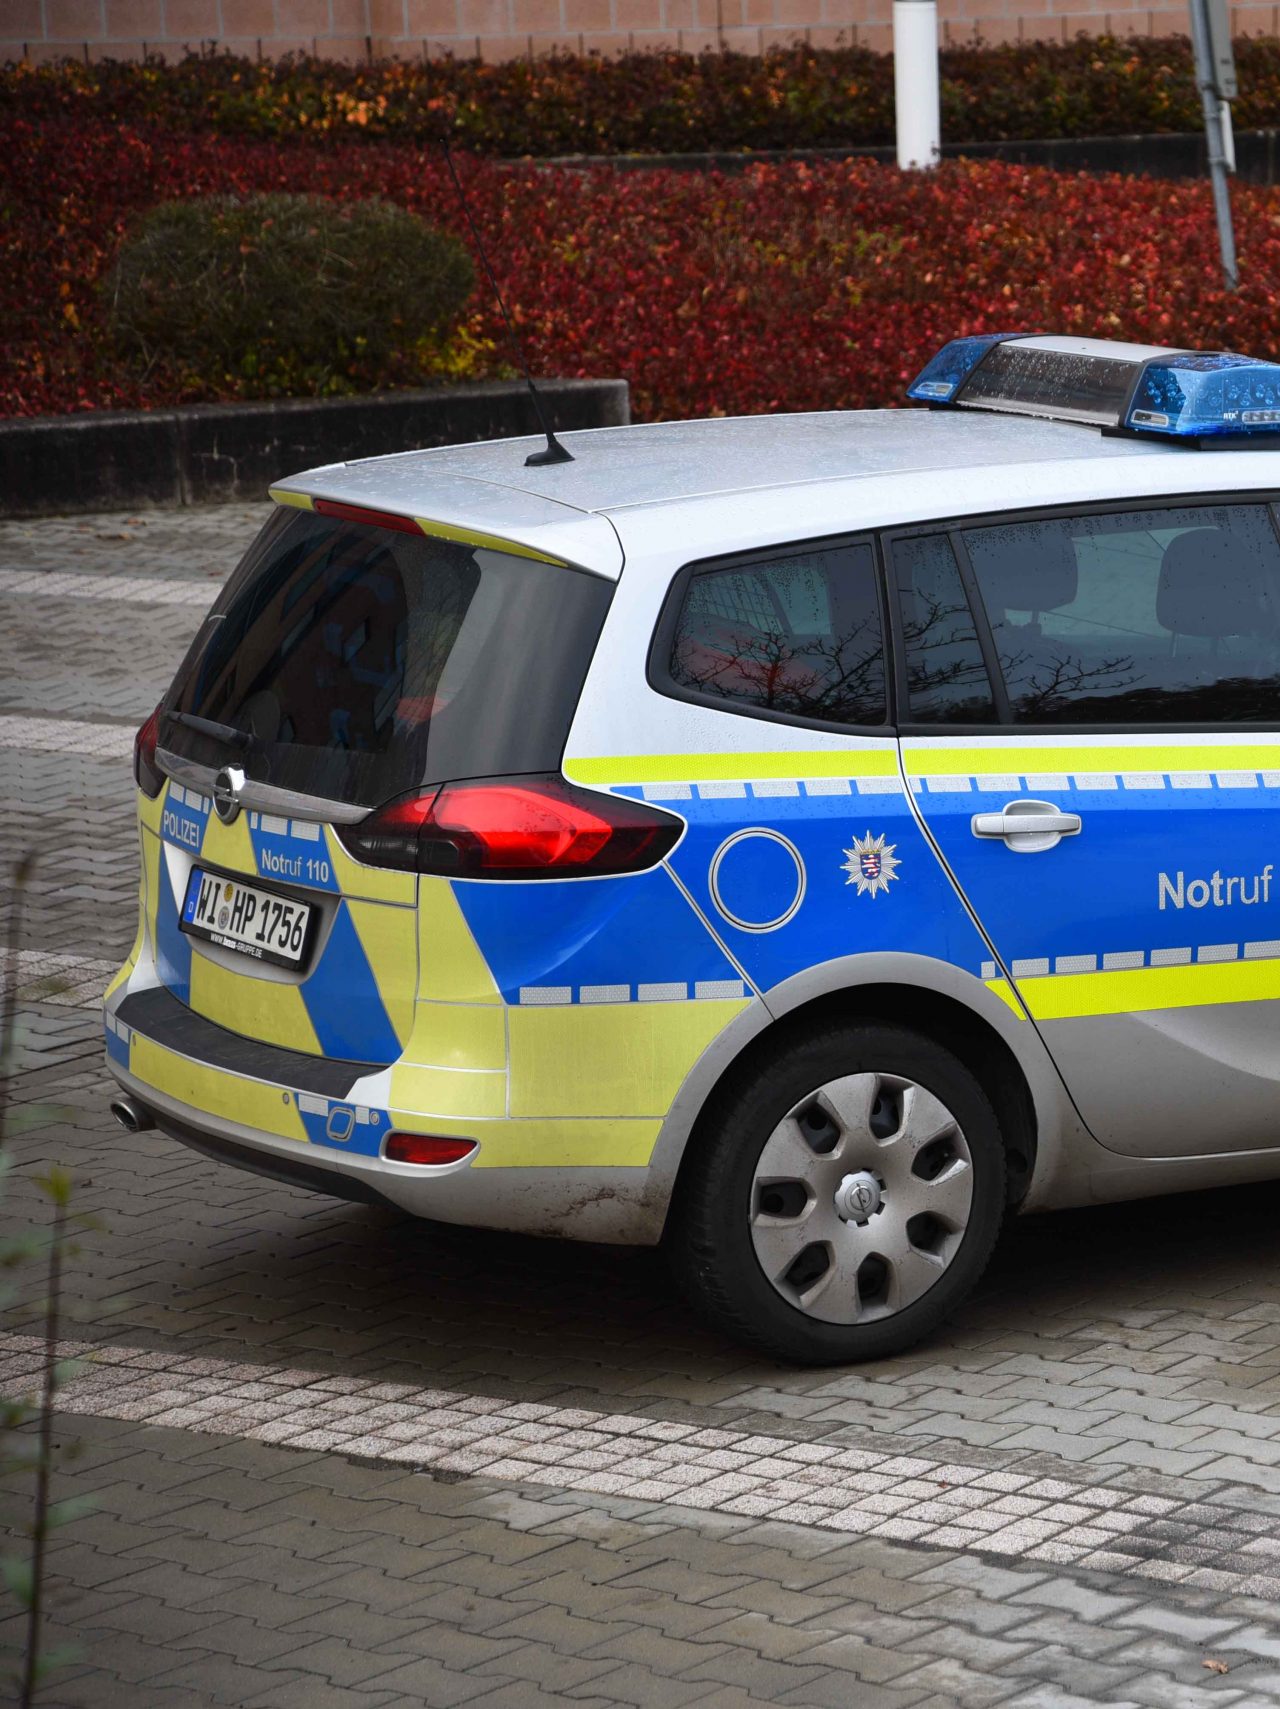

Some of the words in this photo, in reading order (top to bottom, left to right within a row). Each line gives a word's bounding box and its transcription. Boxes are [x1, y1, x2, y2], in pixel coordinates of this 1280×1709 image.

[163, 812, 200, 848] POLIZEI
[261, 848, 302, 877] Notruf
[306, 858, 329, 883] 110
[1158, 864, 1274, 910] Notruf
[188, 902, 194, 913] D
[196, 878, 221, 925] WI
[229, 889, 257, 935] HP
[255, 899, 305, 952] 1756
